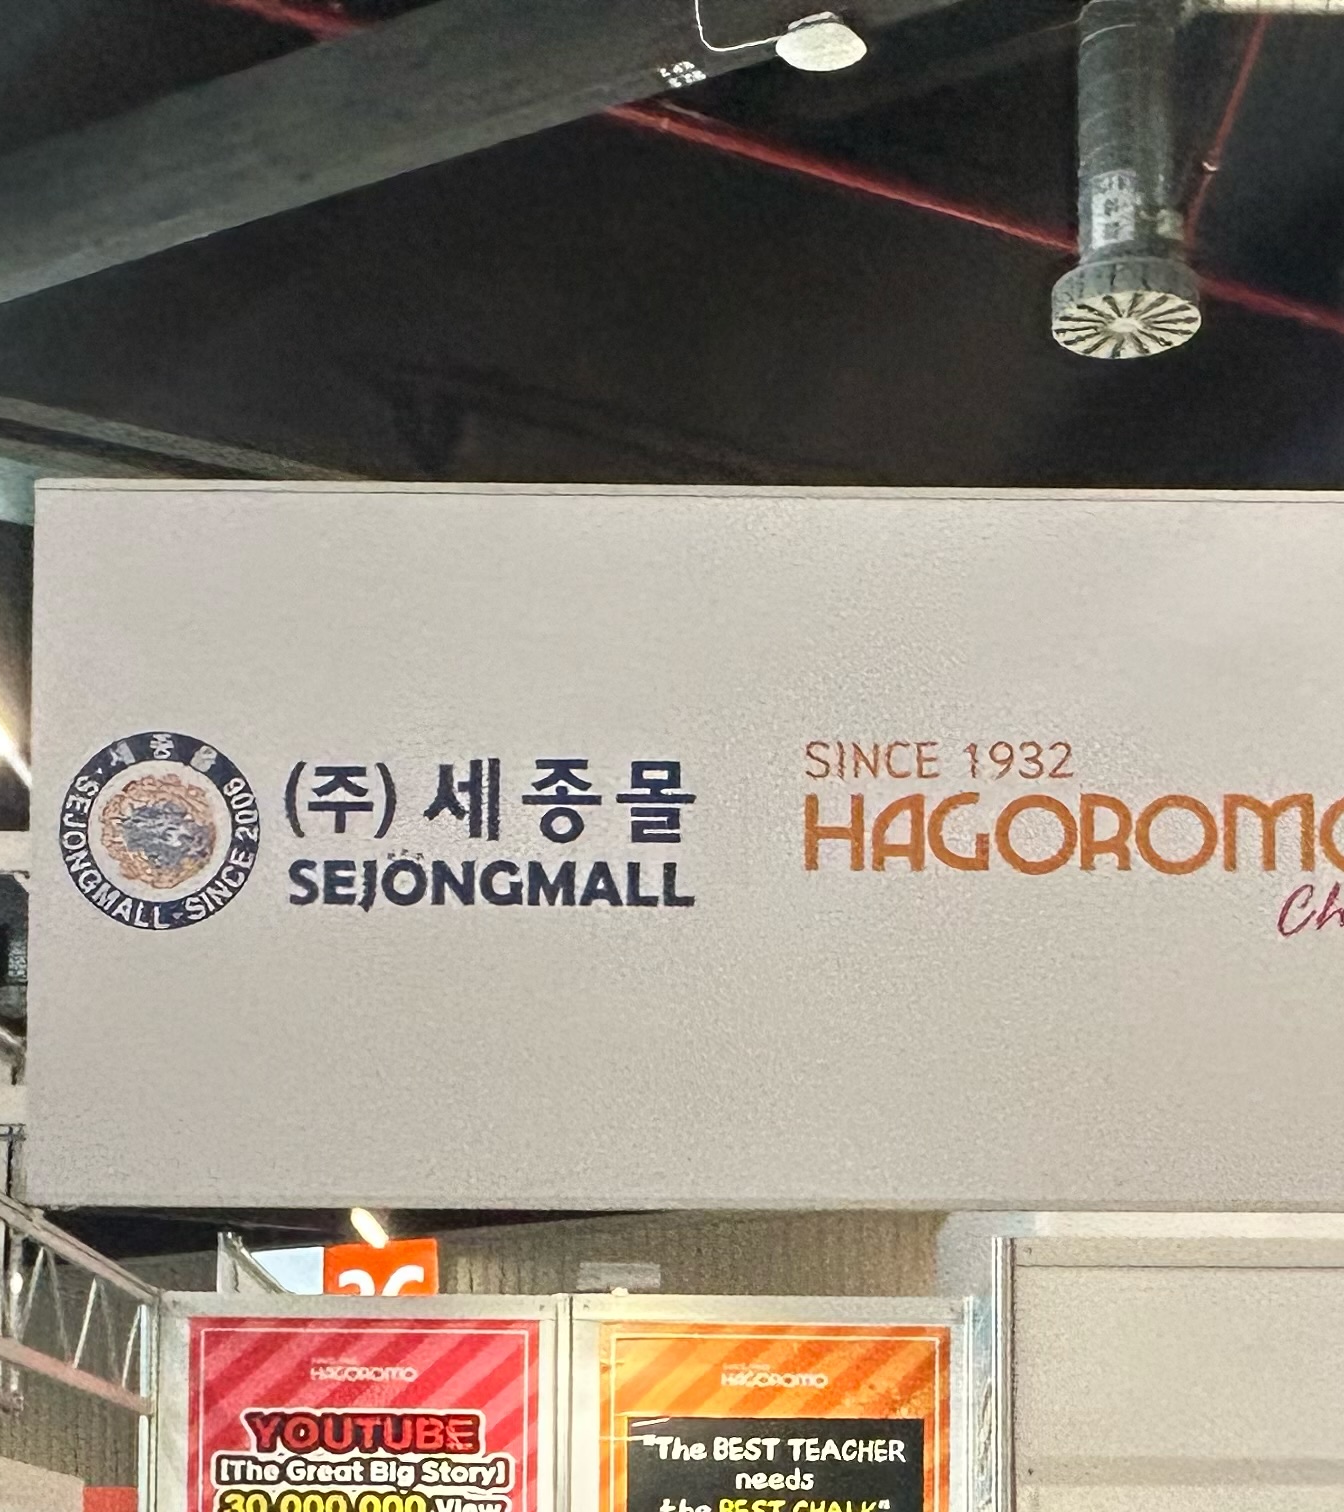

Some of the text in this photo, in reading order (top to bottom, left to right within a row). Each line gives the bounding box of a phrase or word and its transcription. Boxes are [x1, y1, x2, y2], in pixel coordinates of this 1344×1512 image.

[804, 740, 1075, 780] SINCE 1932
[284, 760, 397, 839] (주)
[252, 1413, 477, 1451] YOUTUBE
[712, 1436, 781, 1462] BEST
[787, 1437, 907, 1463] TEACHER
[286, 1459, 364, 1483] Great
[369, 1460, 415, 1487] Big
[735, 1467, 815, 1491] needs
